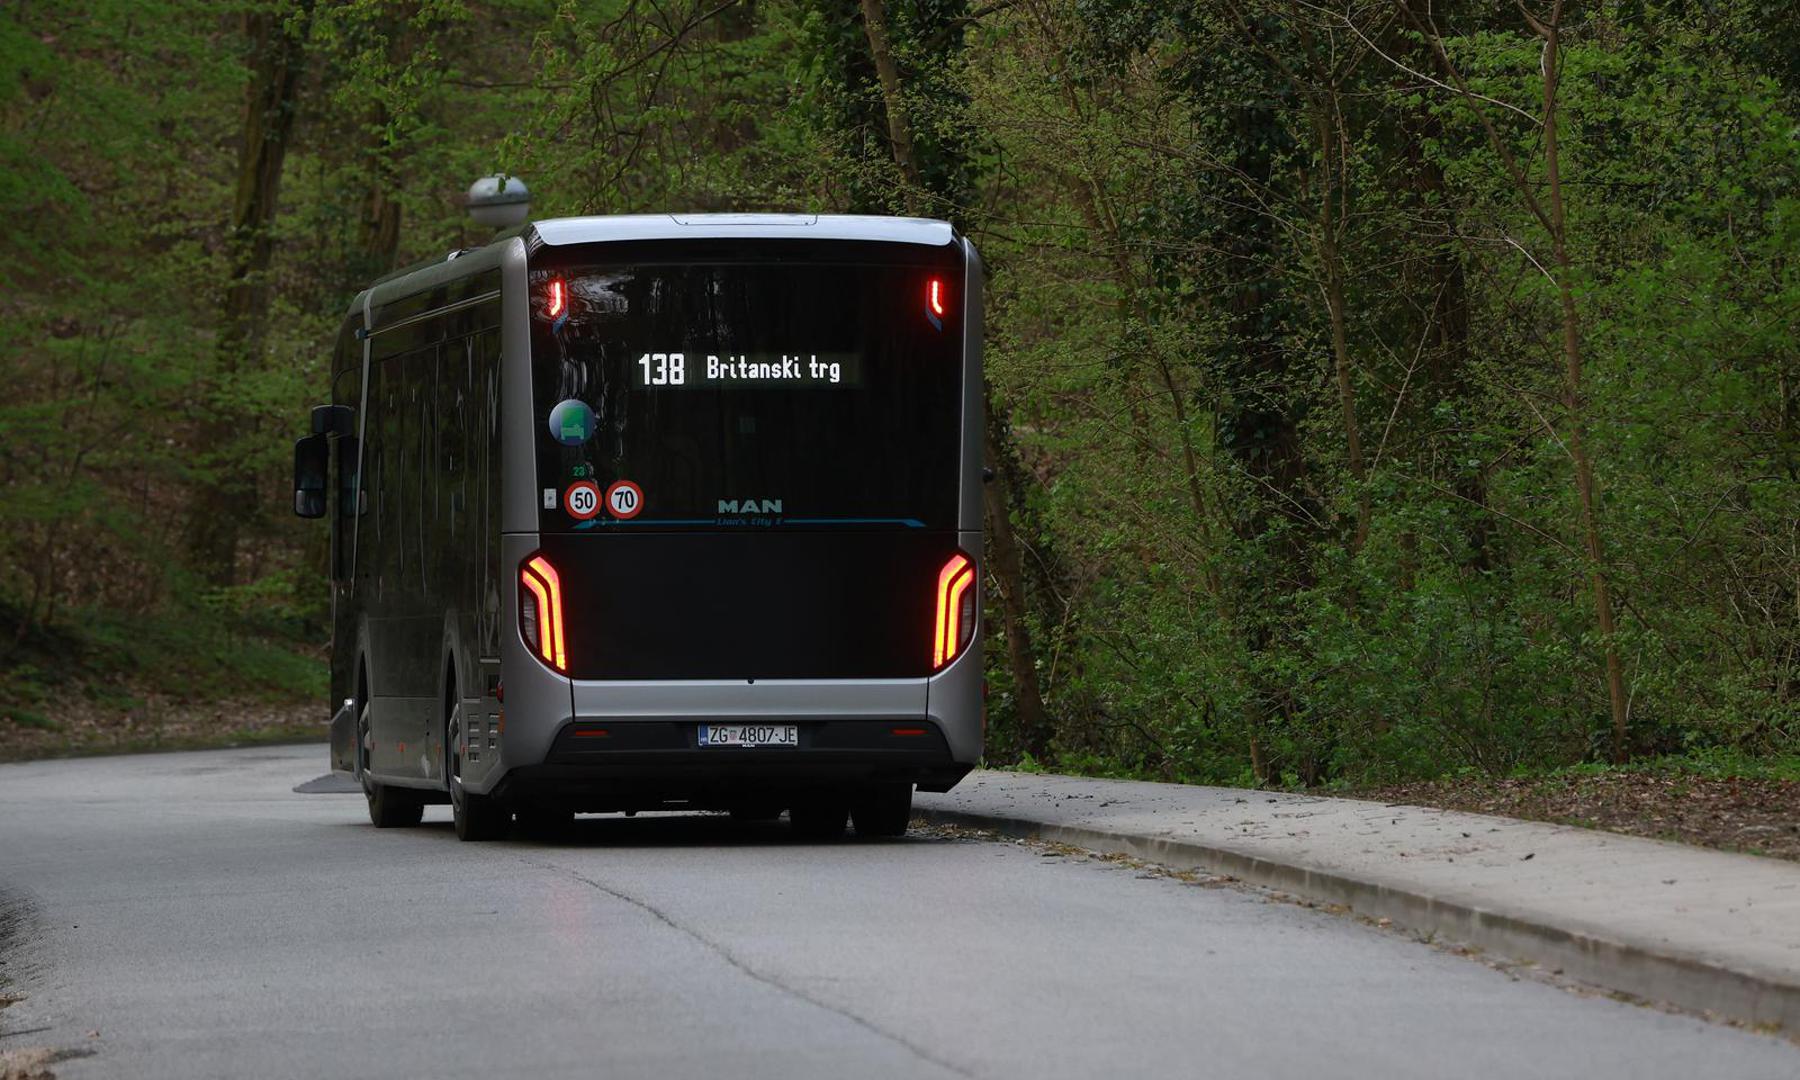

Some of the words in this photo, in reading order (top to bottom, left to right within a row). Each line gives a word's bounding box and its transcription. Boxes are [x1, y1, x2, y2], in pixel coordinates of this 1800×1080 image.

[638, 353, 685, 385] 138
[706, 355, 801, 379] Britanski
[809, 355, 841, 383] trg
[574, 491, 594, 510] 50
[614, 490, 635, 510] 70
[718, 499, 782, 513] MAN
[710, 727, 729, 743] ZG
